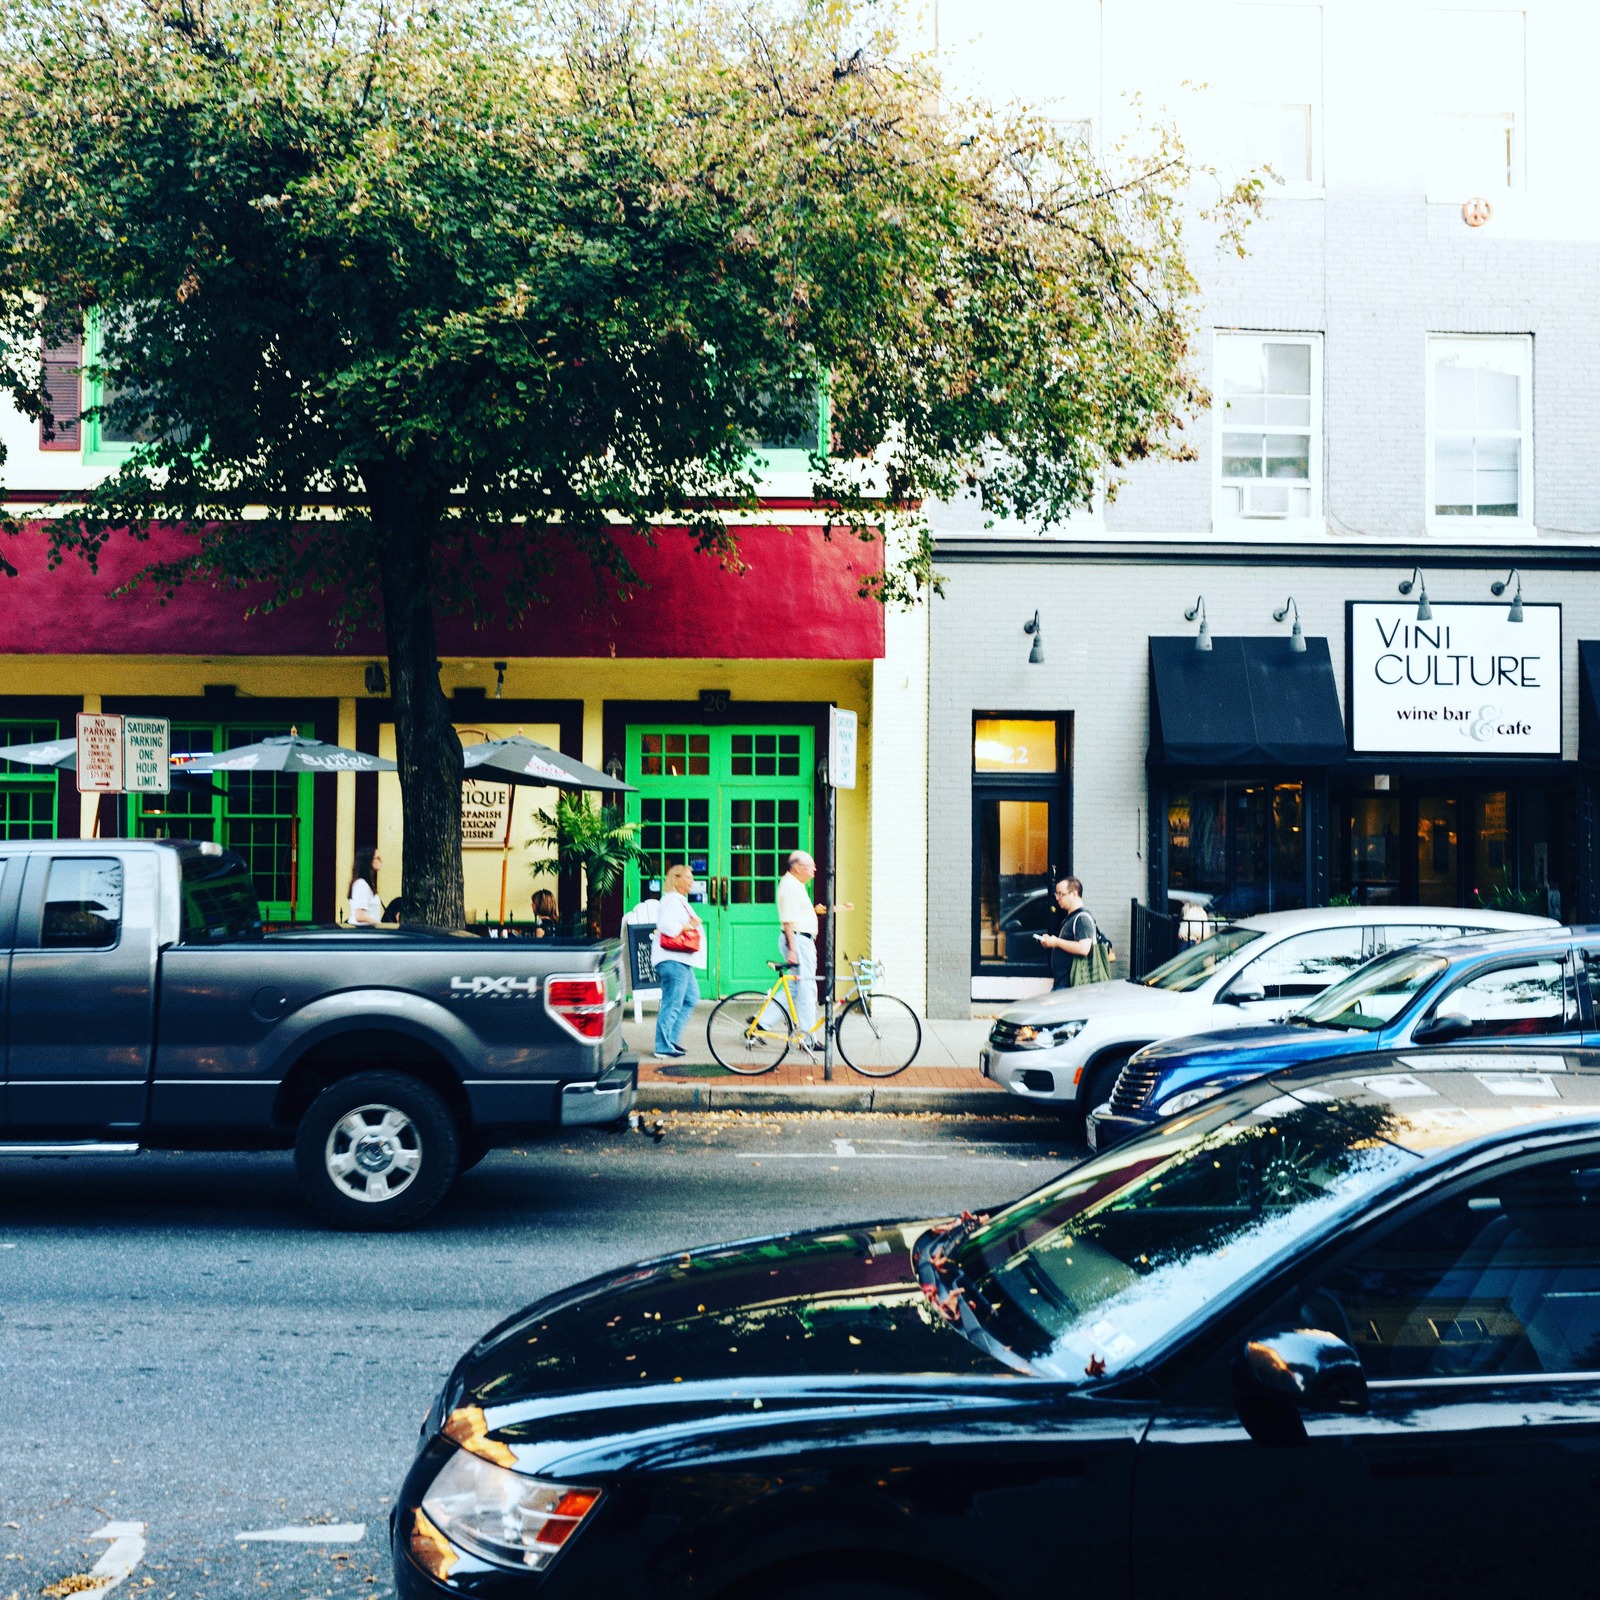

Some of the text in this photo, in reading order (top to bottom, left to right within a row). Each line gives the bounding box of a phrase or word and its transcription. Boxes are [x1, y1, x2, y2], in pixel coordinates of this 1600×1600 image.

[1375, 618, 1450, 649] VINI
[1375, 654, 1541, 688] CULTURE
[704, 693, 727, 712] 26
[95, 719, 106, 727] NO
[127, 722, 165, 734] SATURDAY
[1397, 704, 1532, 742] wine bar & cafe
[83, 727, 117, 737] PARKING
[130, 736, 163, 748] PARKING
[138, 749, 154, 760] ONE
[136, 762, 158, 773] HOUR
[137, 776, 156, 786] LIMIT
[462, 791, 506, 807] IQUE
[461, 811, 502, 819] SPANISH
[462, 820, 497, 829] EXICAN
[462, 830, 494, 839] UISINE
